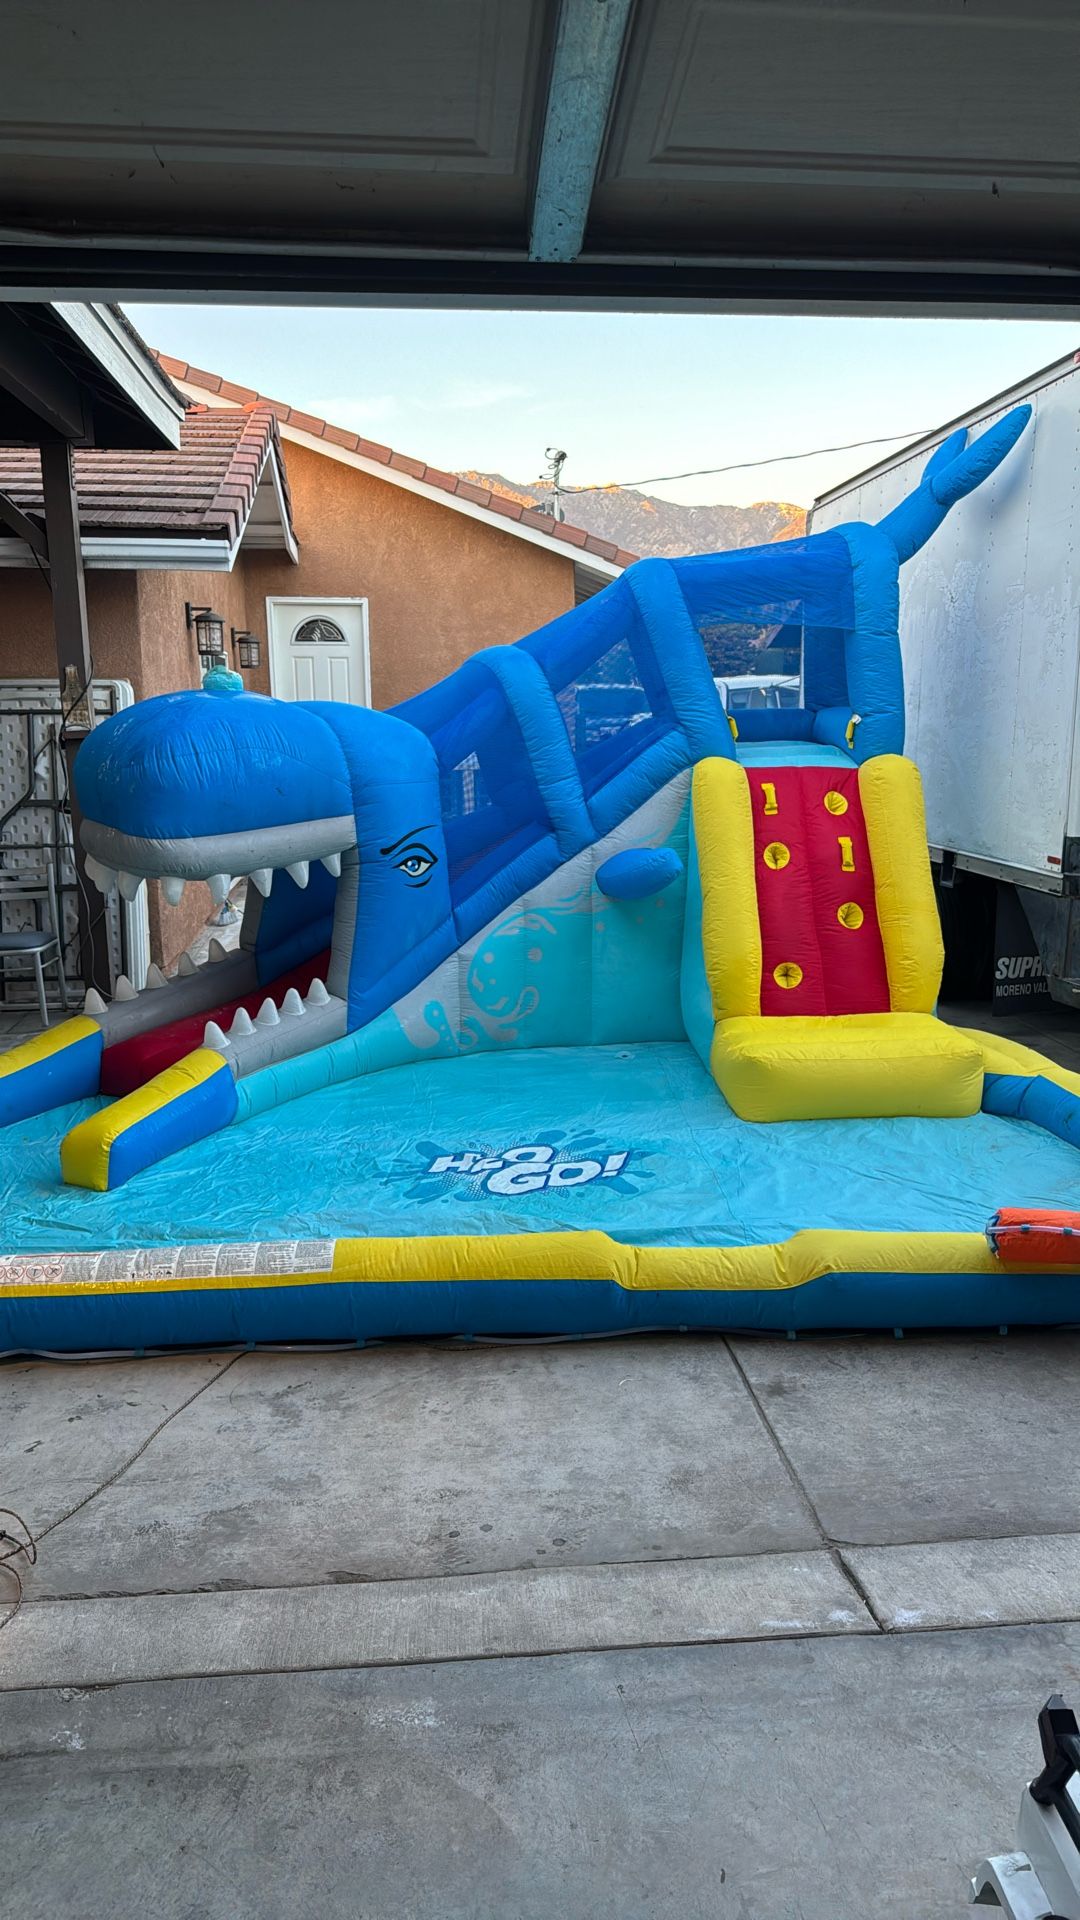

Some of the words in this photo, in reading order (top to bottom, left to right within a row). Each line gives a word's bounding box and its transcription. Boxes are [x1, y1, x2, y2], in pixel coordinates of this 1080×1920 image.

[995, 956, 1045, 980] SUPR
[996, 984, 1031, 997] MORENO
[487, 1151, 627, 1194] GO!
